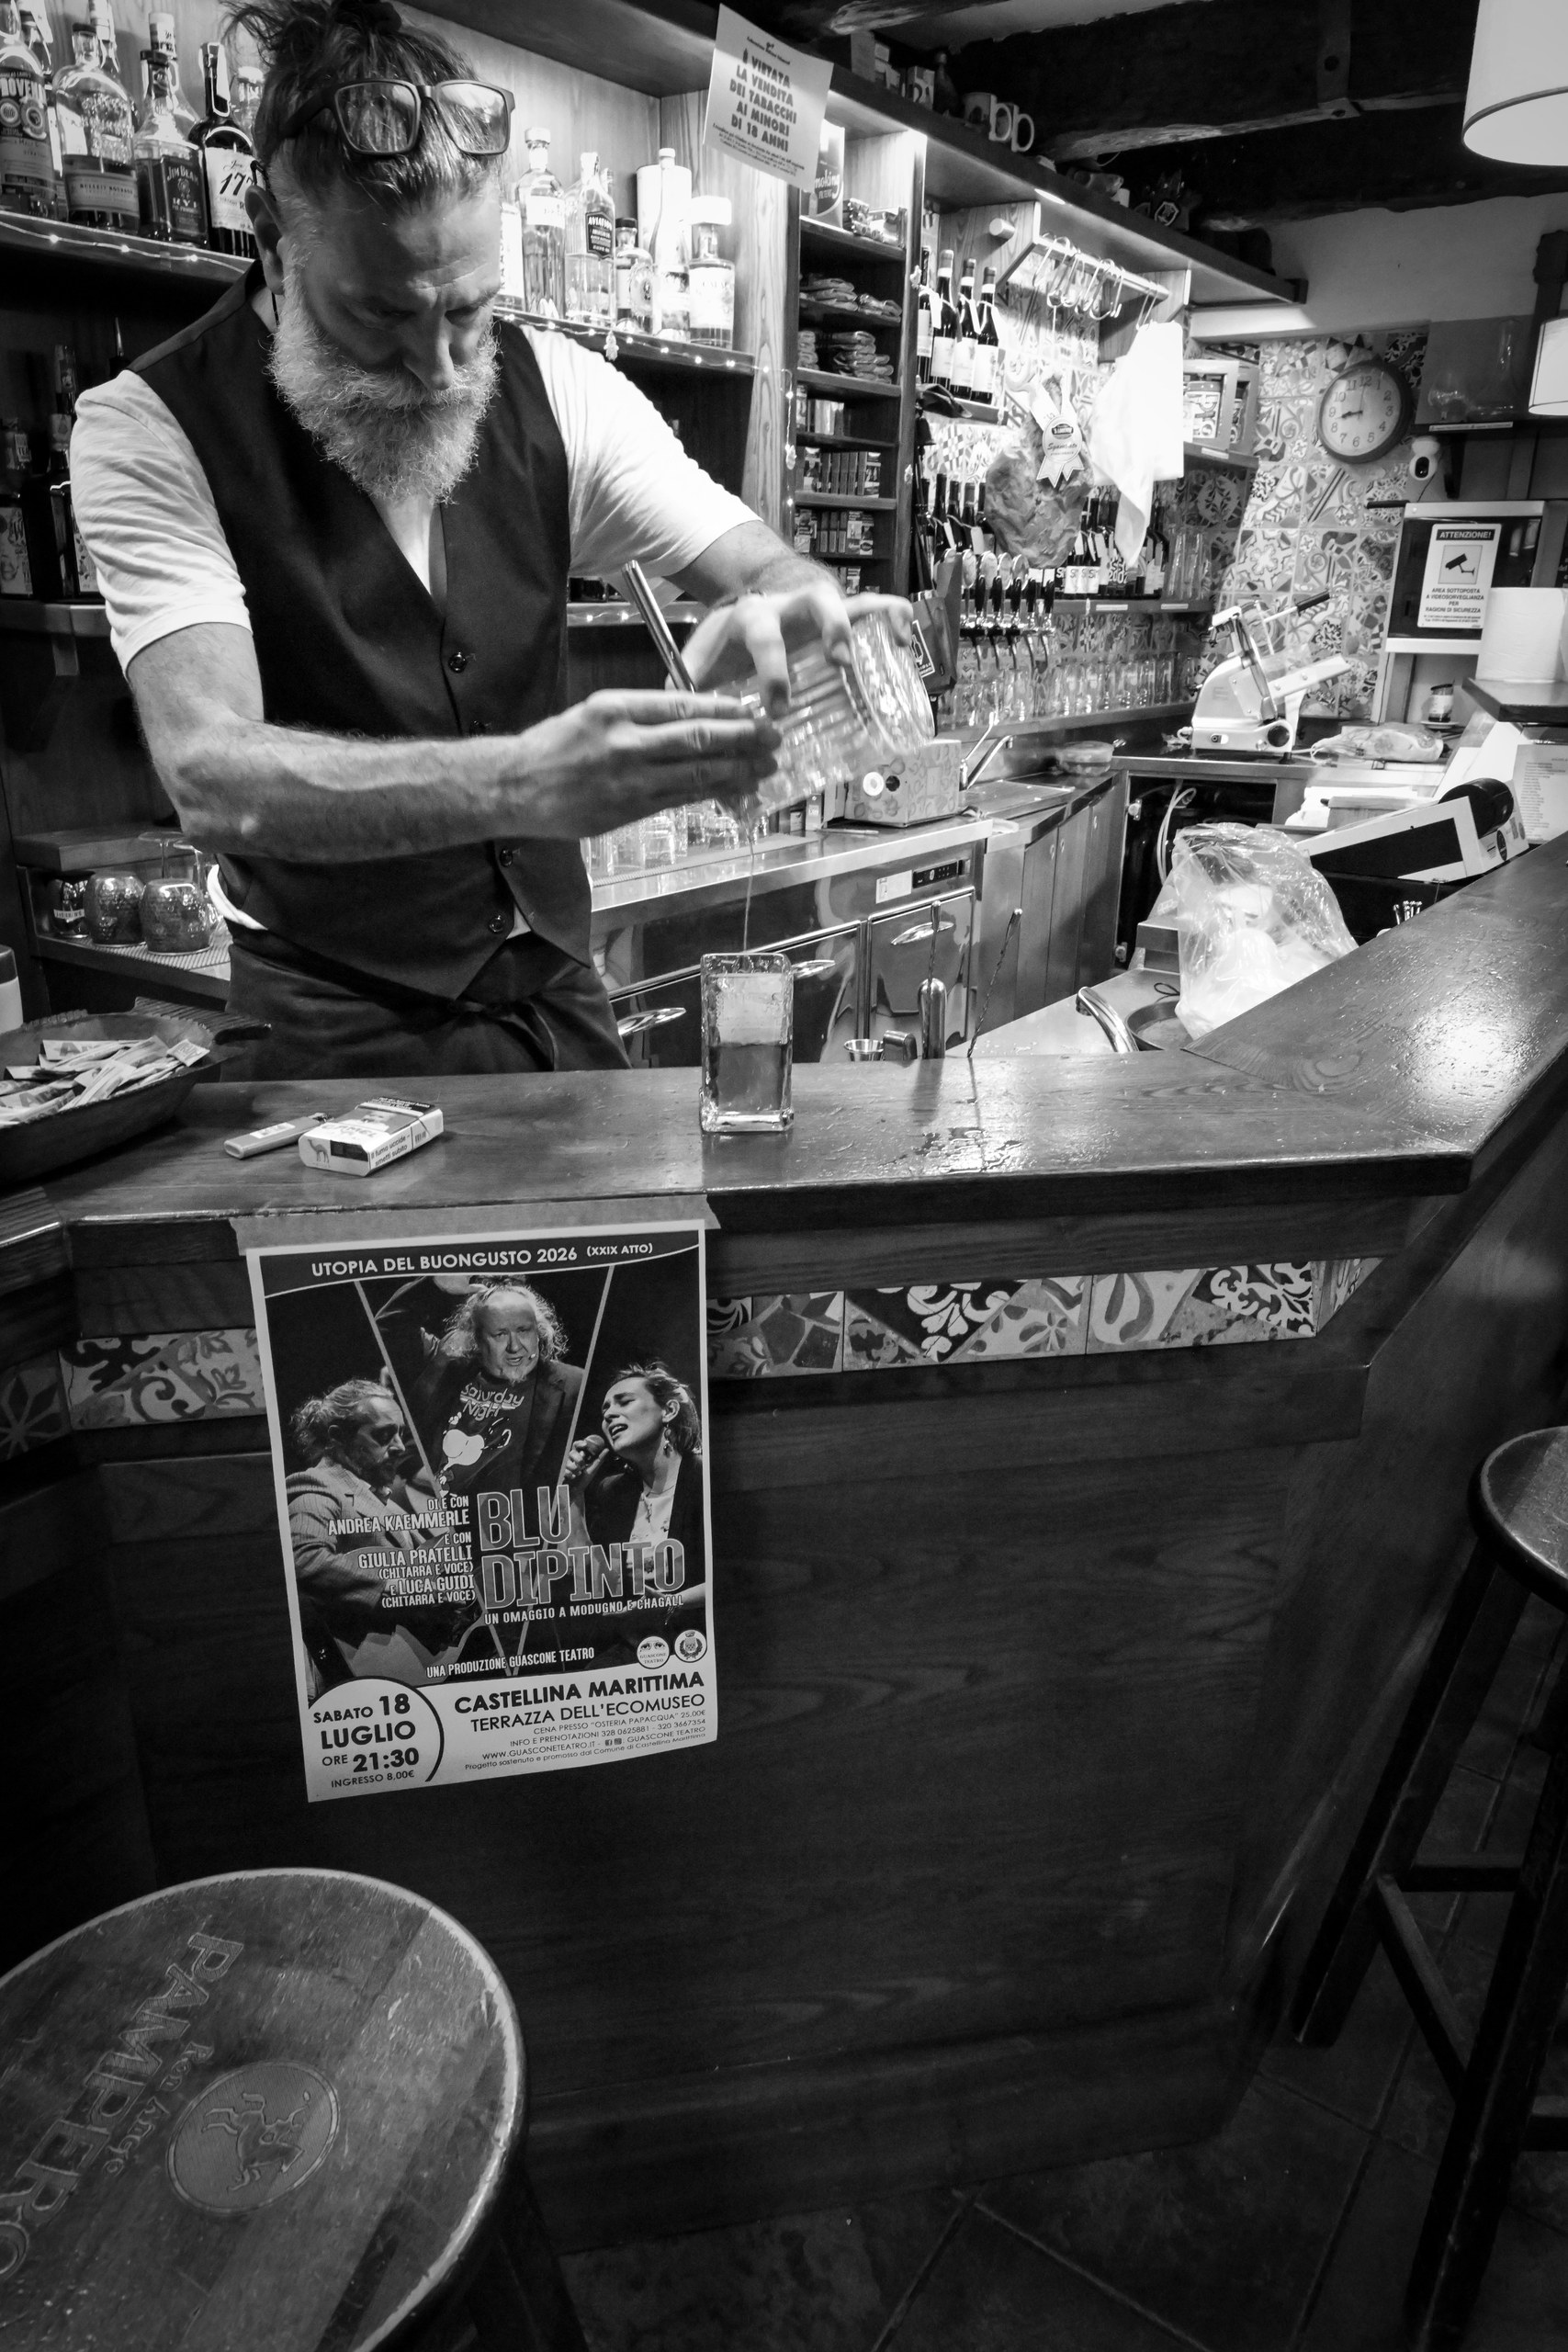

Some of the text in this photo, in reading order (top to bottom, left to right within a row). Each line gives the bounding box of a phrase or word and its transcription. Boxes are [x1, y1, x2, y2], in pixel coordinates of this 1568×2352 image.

[751, 55, 791, 89] VIETATA
[736, 64, 794, 107] LA VENDITA
[729, 78, 797, 124] DEI TABACCHI
[736, 101, 790, 137] AI MINORI
[731, 114, 789, 153] DI 18 ANNI
[1347, 379, 1357, 390] 11
[1359, 375, 1372, 387] 12
[1376, 379, 1381, 390] 1
[1335, 391, 1347, 402] 10
[1383, 390, 1392, 401] 2
[1328, 406, 1337, 418] 9
[1385, 405, 1393, 417] 3
[1330, 422, 1338, 433] 8
[1379, 421, 1386, 432] 4
[1339, 433, 1348, 444] 7
[1352, 435, 1360, 447] 6
[1367, 432, 1375, 443] 5
[1439, 531, 1492, 539] ATTENZIONE!
[375, 1146, 389, 1157] fumo
[389, 1136, 406, 1148] uccide
[375, 1145, 408, 1166] smetti subito
[312, 1242, 654, 1277] UTOPIA DEL BUONGUSTO 2026 (XXIX ATTO)
[427, 1496, 469, 1510] DI E CON
[328, 1509, 470, 1535] ANDREA KAEMMERLE
[477, 1484, 572, 1552] BLU
[445, 1532, 472, 1545] E CON
[358, 1545, 473, 1569] GIULIA PRATELLI
[378, 1561, 474, 1580] (CHITARRA E VOCE)
[481, 1538, 685, 1610] DIPINTO
[390, 1575, 475, 1596] E LUCA GUIDI
[381, 1589, 476, 1609] (CHITARRA E VOCE)
[484, 1595, 684, 1625] UN OMAGGIO A MODUGNO E CHAGALL
[426, 1646, 595, 1679] UNA PRODUZIONE GUASCONE TEATRO
[454, 1670, 705, 1714] CASTELLINA MARITTIMA
[313, 1692, 412, 1724] SABATO 18
[471, 1693, 705, 1733] TERRAZZA DELL'ECOMUSEO
[321, 1720, 416, 1749] LUGLIO
[510, 1738, 531, 1747] INFO
[533, 1736, 537, 1745] E
[539, 1731, 600, 1744] PRENOTAZIONI
[602, 1729, 615, 1737] 328
[617, 1725, 650, 1736] 0625881
[658, 1723, 671, 1731] 320
[673, 1717, 706, 1729] 3667354
[534, 1725, 557, 1735] CENA
[559, 1722, 589, 1732] PRESSO
[482, 1740, 595, 1760] WWW.GUASCONETEATRO.IT
[627, 1731, 674, 1743] GUASCONE
[677, 1725, 706, 1736] TEATRO
[321, 1747, 419, 1773] ORE 21:30
[465, 1759, 497, 1771] Progetto
[499, 1756, 534, 1767] sostenuto
[543, 1751, 579, 1764] promosso
[581, 1748, 592, 1758] dal
[593, 1745, 626, 1756] Comune
[636, 1737, 671, 1749] Castellina
[331, 1773, 383, 1789] INGRESSO
